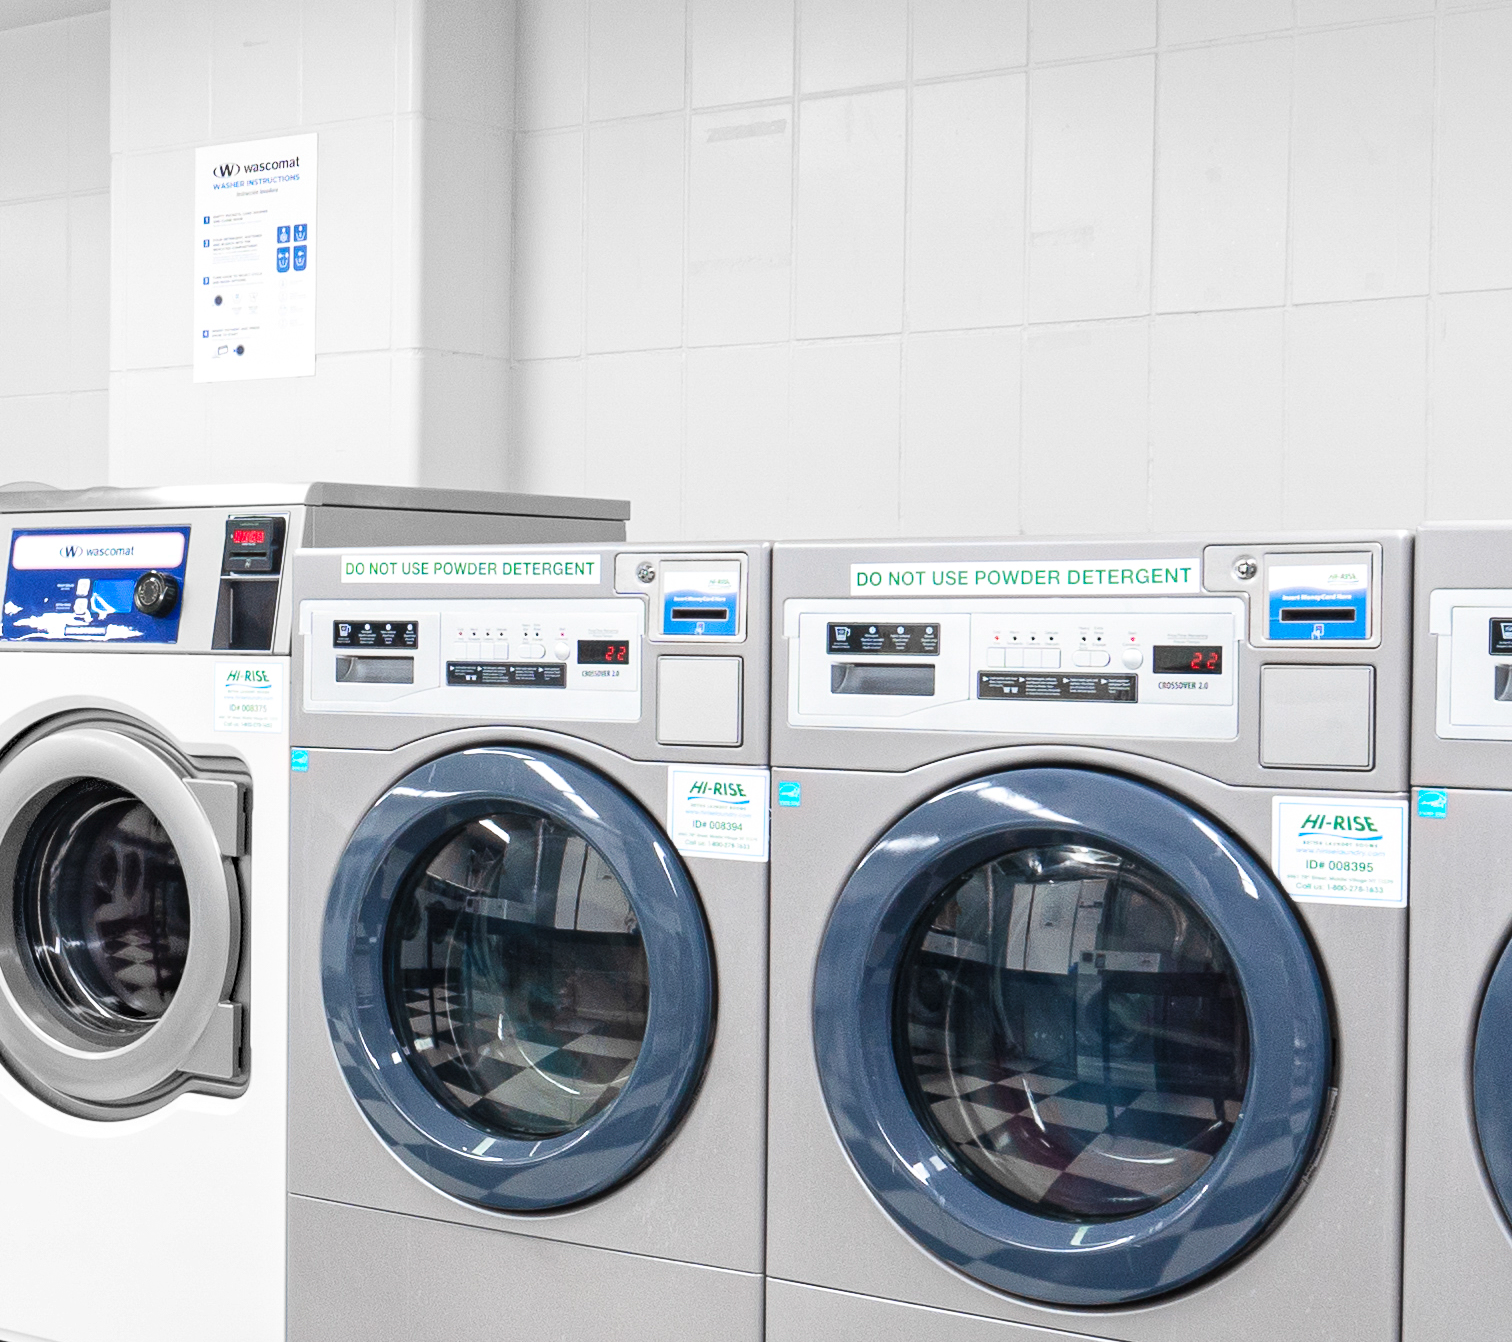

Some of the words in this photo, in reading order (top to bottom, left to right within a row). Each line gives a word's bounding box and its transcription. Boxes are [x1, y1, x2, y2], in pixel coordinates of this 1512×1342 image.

[243, 156, 300, 174] wascomat
[213, 180, 245, 190] WASHER
[247, 174, 300, 186] INSTRUCTIONS
[87, 546, 134, 556] wascomat
[345, 562, 365, 575] DO
[369, 562, 397, 575] NOT
[402, 562, 429, 575] USE
[434, 562, 497, 575] POWDER
[503, 562, 595, 576] DETERGENT
[857, 572, 882, 586] DO
[888, 571, 926, 586] NOT
[932, 571, 968, 586] USE
[975, 570, 1060, 585] POWDER
[1067, 567, 1192, 584] DETERGENT
[605, 646, 626, 661] 22
[1190, 652, 1219, 669] 22
[227, 670, 269, 682] HI-RISE
[229, 704, 240, 712] ID#
[242, 704, 267, 712] 008375
[689, 781, 747, 797] HI-RISE
[693, 820, 707, 828] ID#
[710, 821, 742, 831] 008394
[1301, 814, 1378, 832] HI-RISE
[1306, 860, 1325, 869] ID#
[1329, 861, 1373, 873] 008395
[1296, 882, 1311, 890] Call
[1328, 884, 1384, 894] 1-800-278-1633
